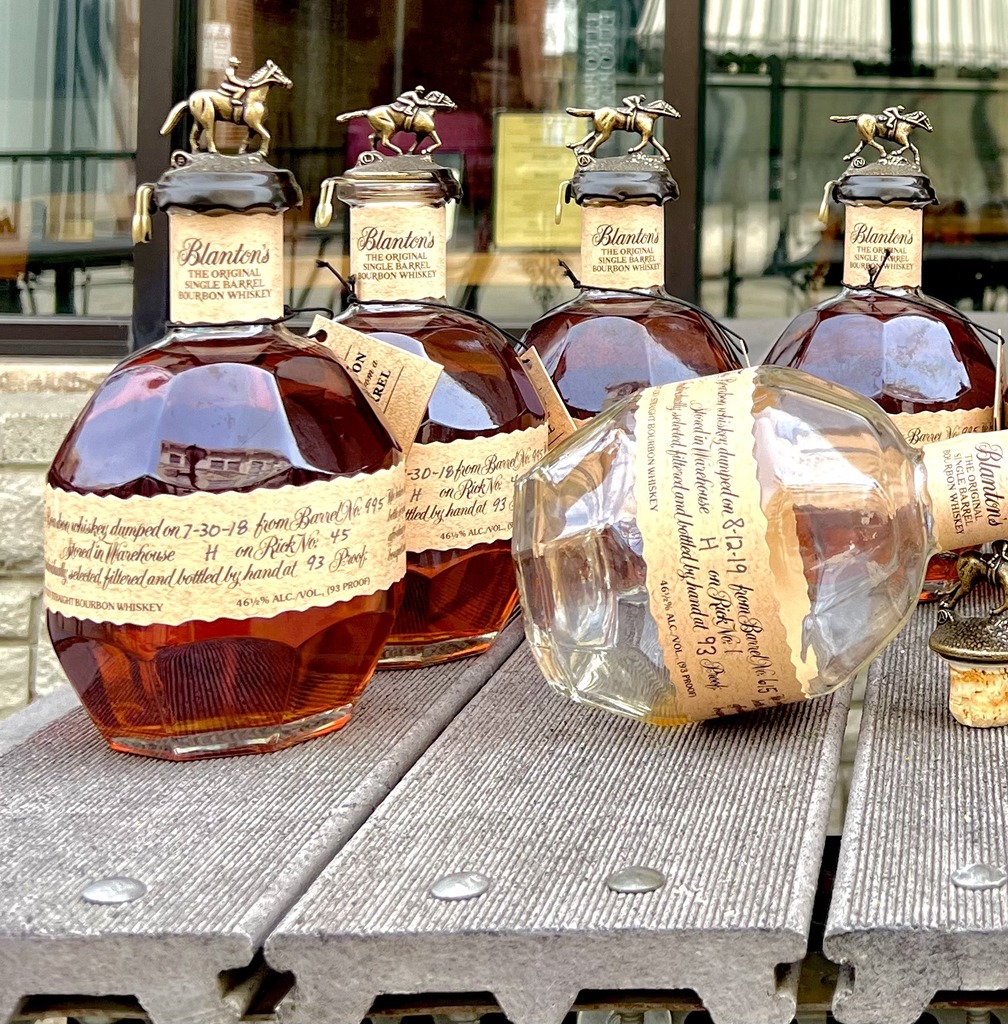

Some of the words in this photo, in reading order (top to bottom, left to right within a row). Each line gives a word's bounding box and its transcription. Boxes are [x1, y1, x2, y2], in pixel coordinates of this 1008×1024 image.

[357, 226, 435, 251] Blanton's
[592, 223, 660, 247] Blanton's
[850, 222, 914, 245] Blanton's
[178, 237, 270, 266] Blanton's
[366, 253, 383, 261] THE
[385, 252, 427, 260] ORIGINAL
[598, 256, 627, 264] SINGLE
[629, 255, 656, 263] BARREL
[854, 254, 880, 262] SINGLE
[188, 269, 208, 278] THE
[211, 269, 261, 277] ORIGINAL
[358, 272, 397, 281] BOURBON
[400, 270, 436, 279] WHISKEY
[363, 262, 397, 270] SINGLE
[592, 264, 630, 273] BOURBON
[632, 263, 660, 272] WHISKEY
[179, 292, 224, 301] BOURBON
[227, 289, 272, 299] WHISKEY
[185, 280, 220, 289] SINGLE
[223, 279, 264, 289] BARREL
[454, 459, 482, 482] from
[481, 454, 518, 475] Barrel
[692, 438, 715, 514] Warehouse
[715, 449, 739, 499] dumped
[955, 453, 966, 485] SINGLE
[965, 454, 974, 473] THE
[454, 479, 489, 500] Rick
[648, 464, 658, 512] WHISKEY
[943, 450, 955, 491] BOURBON
[950, 495, 964, 535] WHISKEY
[975, 442, 1008, 526] Blanton's
[444, 501, 476, 518] hand
[492, 497, 506, 512] 93
[960, 488, 973, 526] BARREL
[968, 477, 983, 521] ORIGINAL
[109, 518, 165, 542] dumped
[182, 519, 248, 539] 7-30-18
[254, 513, 290, 538] from
[290, 506, 343, 531] Barrel
[103, 540, 175, 565] Warehouse
[205, 544, 219, 561] H
[253, 534, 297, 560] Rick
[330, 529, 350, 544] 45
[677, 516, 700, 566] bottled
[699, 537, 719, 551] H
[102, 568, 149, 590] filtered
[171, 564, 224, 587] bottled
[242, 560, 284, 581] hand
[307, 555, 324, 570] 93
[75, 599, 115, 610] BOURBON
[116, 603, 163, 612] WHISKEY
[343, 577, 370, 590] PROOF)
[687, 580, 709, 620] hand
[707, 587, 734, 625] Rick
[729, 583, 754, 619] from
[697, 637, 716, 655] 93
[738, 617, 769, 664] Barrel
